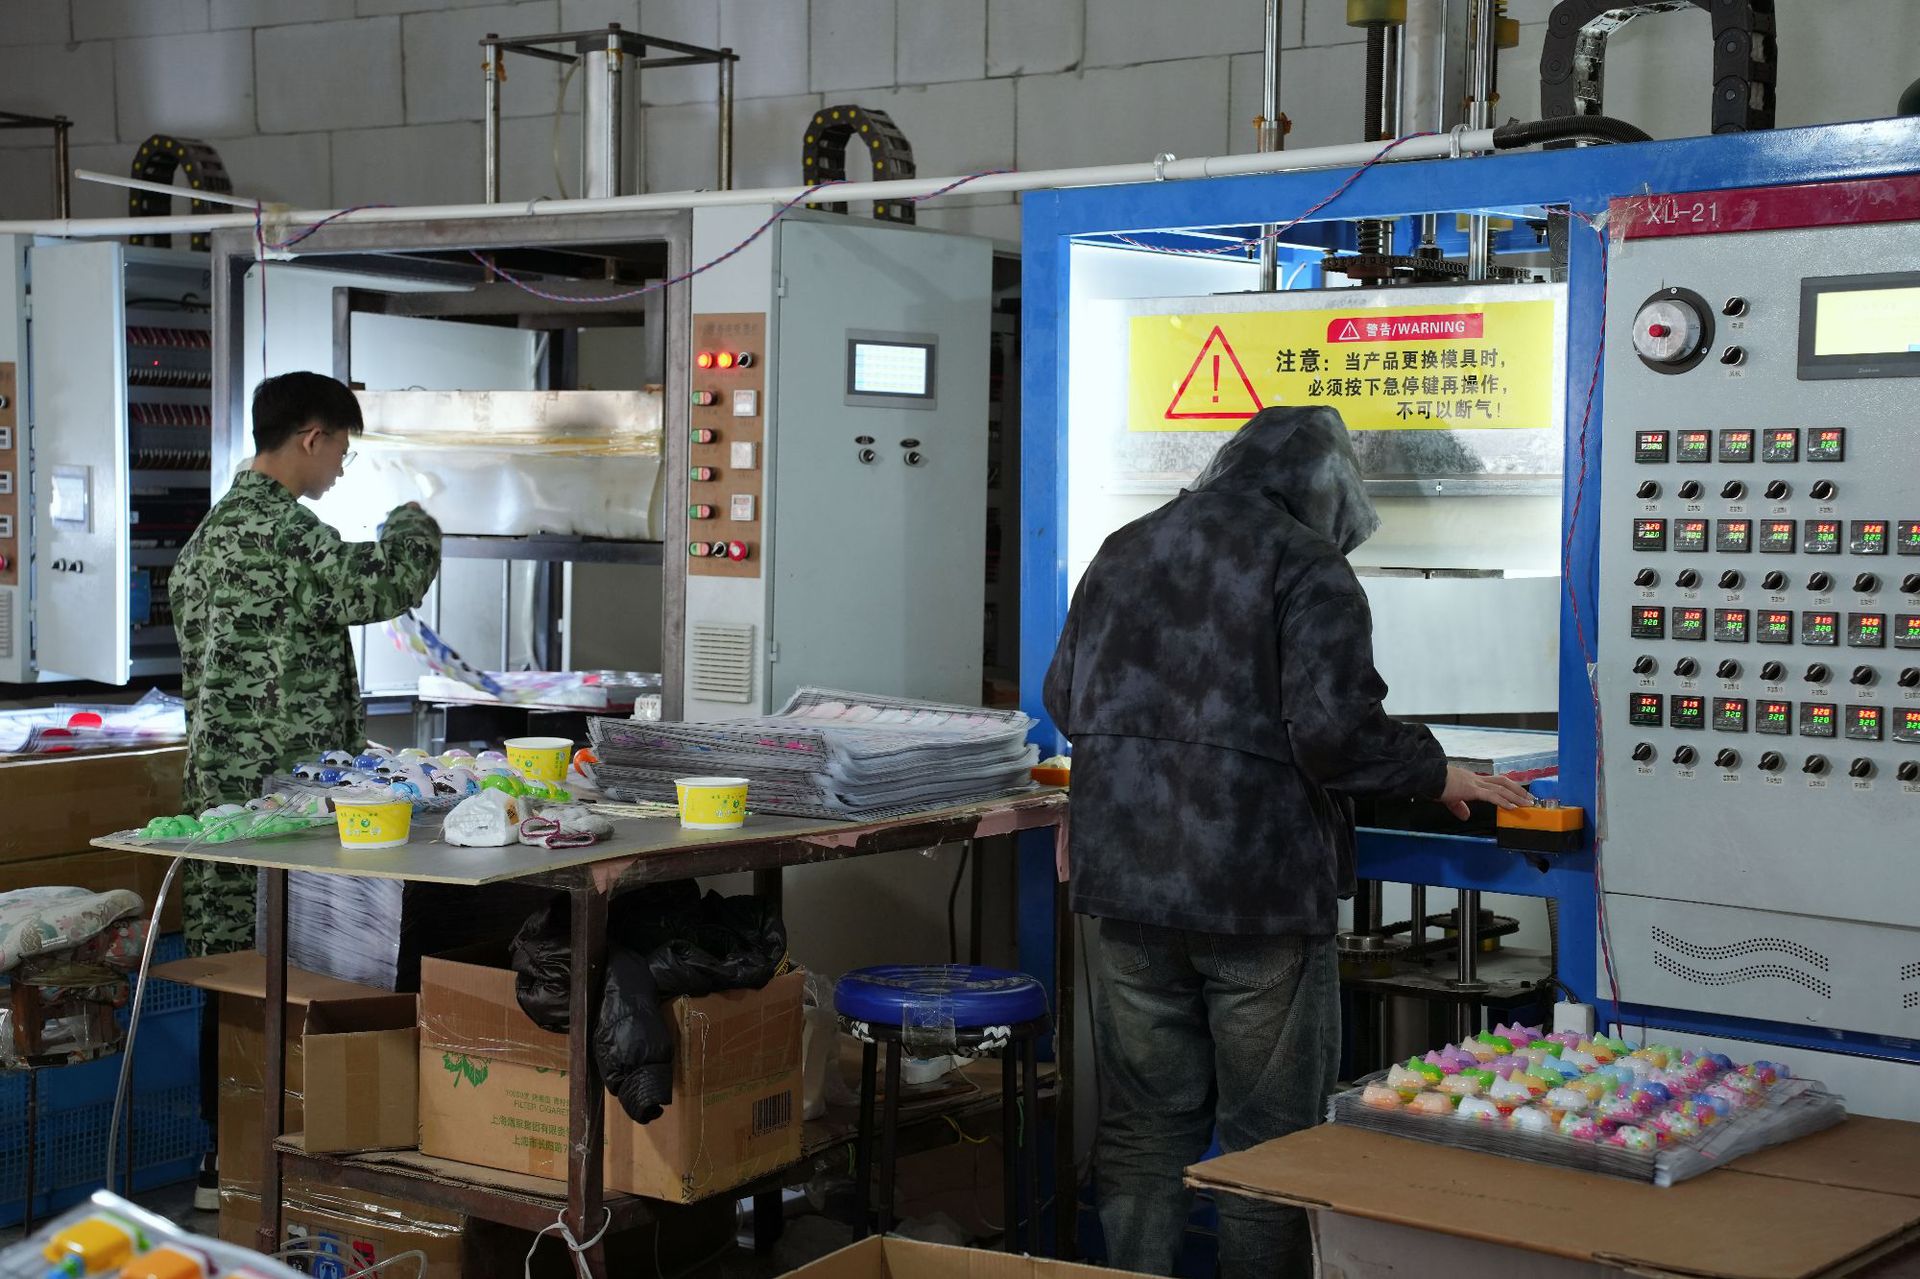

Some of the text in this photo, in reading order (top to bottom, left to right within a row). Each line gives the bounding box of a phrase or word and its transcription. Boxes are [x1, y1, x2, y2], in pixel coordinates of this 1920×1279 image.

[1646, 202, 1719, 225] XL-21
[1365, 319, 1466, 337] 警告/WARNING
[1684, 612, 1700, 620] 320
[1769, 614, 1787, 623] 320
[1815, 624, 1832, 633] 320
[1682, 700, 1698, 708] 319
[1725, 702, 1741, 710] 321
[1682, 708, 1698, 716] 320
[1725, 711, 1741, 719] 320
[1812, 708, 1830, 716] 320
[1768, 713, 1785, 721] 320
[1812, 716, 1830, 724] 320
[1859, 719, 1876, 727] 320
[538, 1104, 569, 1117] CIGARE
